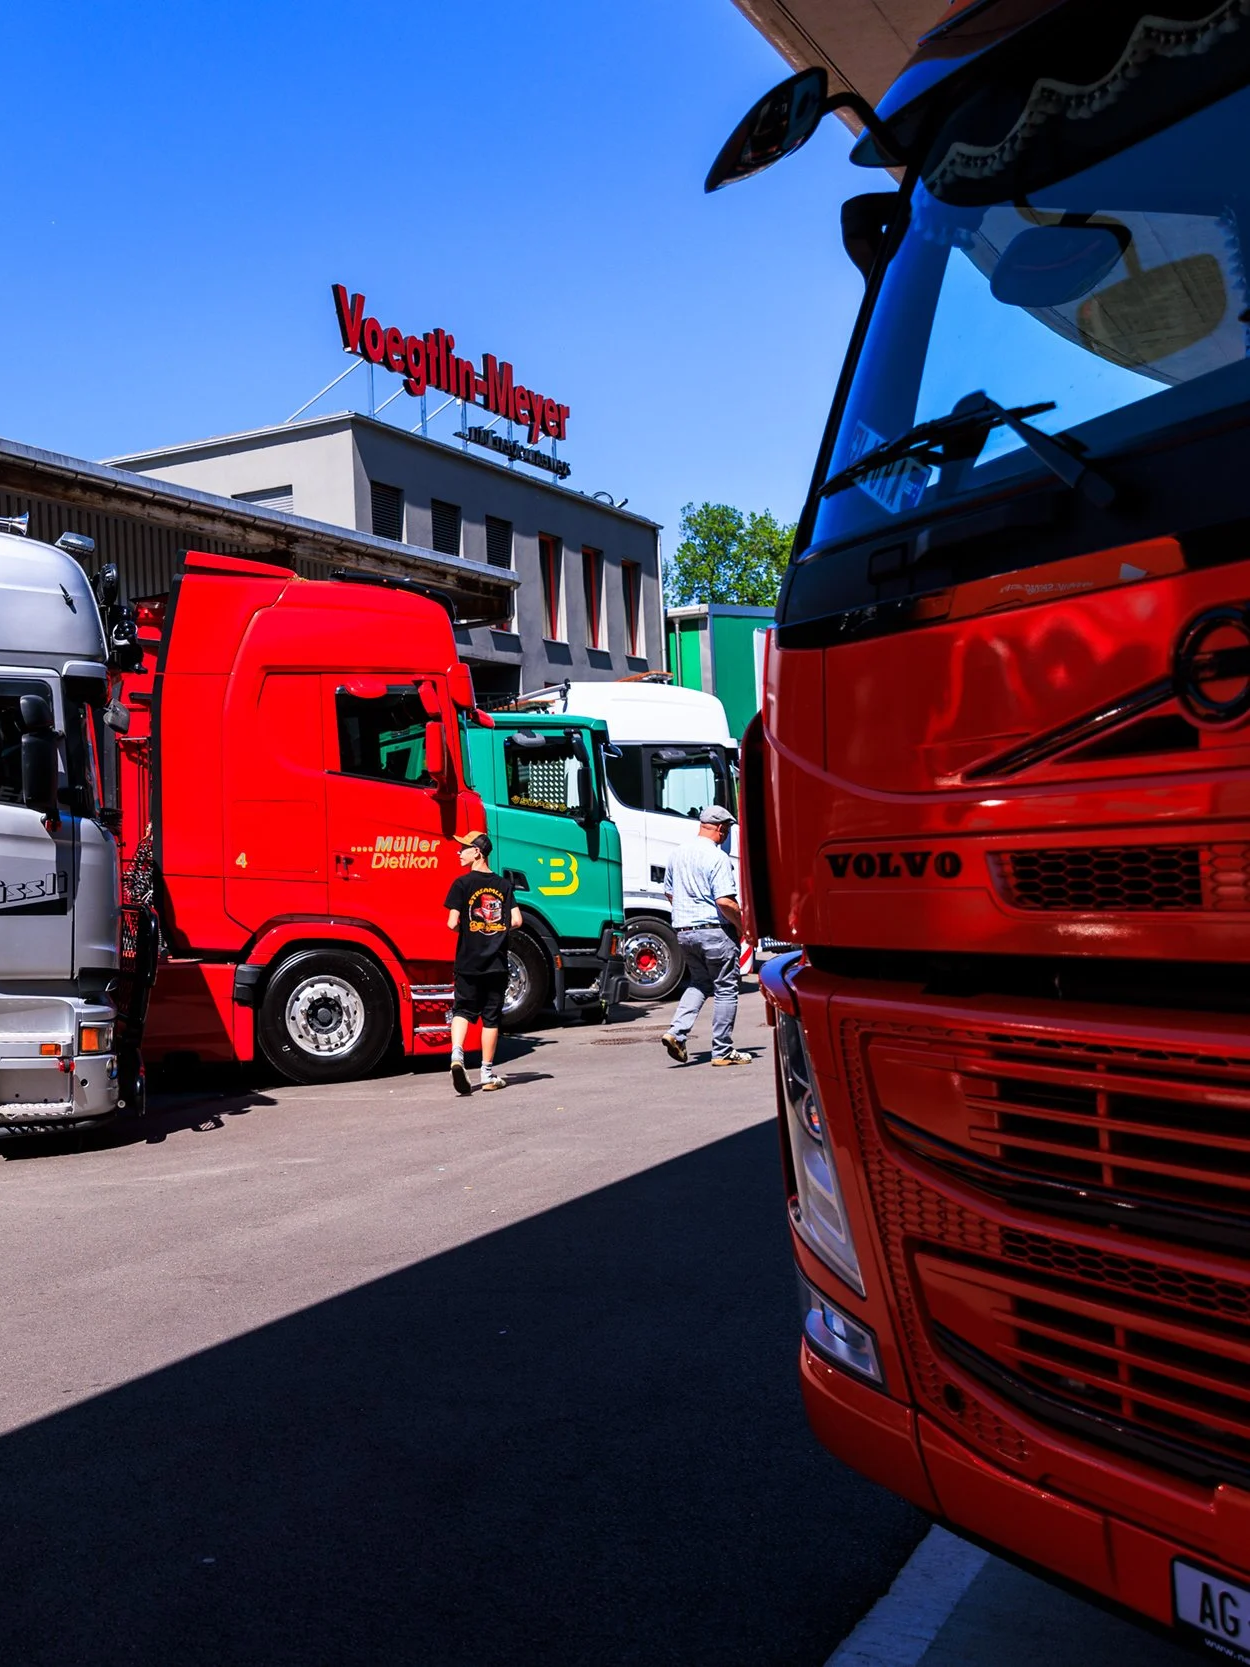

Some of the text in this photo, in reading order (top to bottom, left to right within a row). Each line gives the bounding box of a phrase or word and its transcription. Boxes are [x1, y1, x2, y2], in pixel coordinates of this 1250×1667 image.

[331, 283, 570, 445] Voegtlin-Meyer
[235, 852, 248, 868] 4
[371, 852, 438, 869] Dietikon
[538, 852, 579, 896] B
[825, 851, 962, 879] VOLVO
[1199, 1581, 1240, 1637] AG
